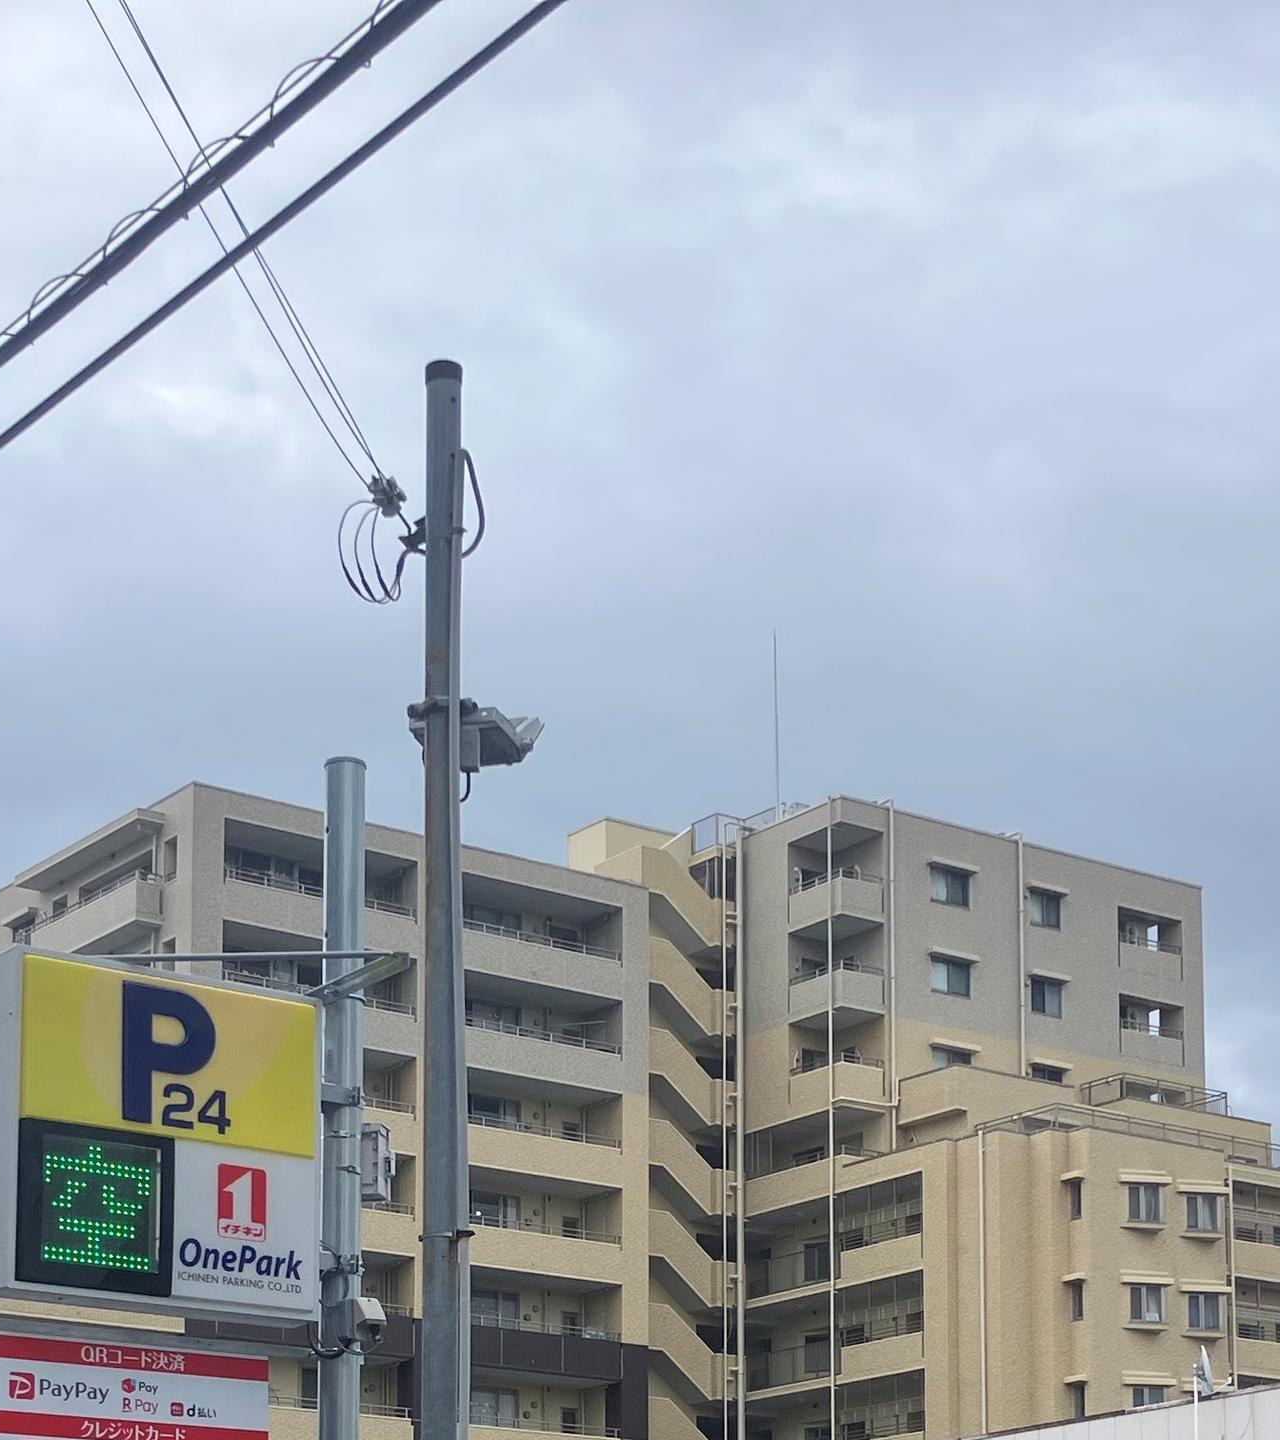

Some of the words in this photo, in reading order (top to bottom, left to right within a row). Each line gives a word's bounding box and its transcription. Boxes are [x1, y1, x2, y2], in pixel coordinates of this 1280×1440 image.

[122, 980, 216, 1124] P
[161, 1083, 231, 1135] 24
[44, 1144, 151, 1270] 空
[179, 1237, 303, 1281] OnePark
[177, 1271, 219, 1285] ICHINEN
[222, 1275, 265, 1290] PARKING
[81, 1345, 186, 1372] QRコード決済
[39, 1378, 110, 1405] PayPay
[138, 1381, 159, 1396] Pay
[135, 1398, 159, 1415] Pay
